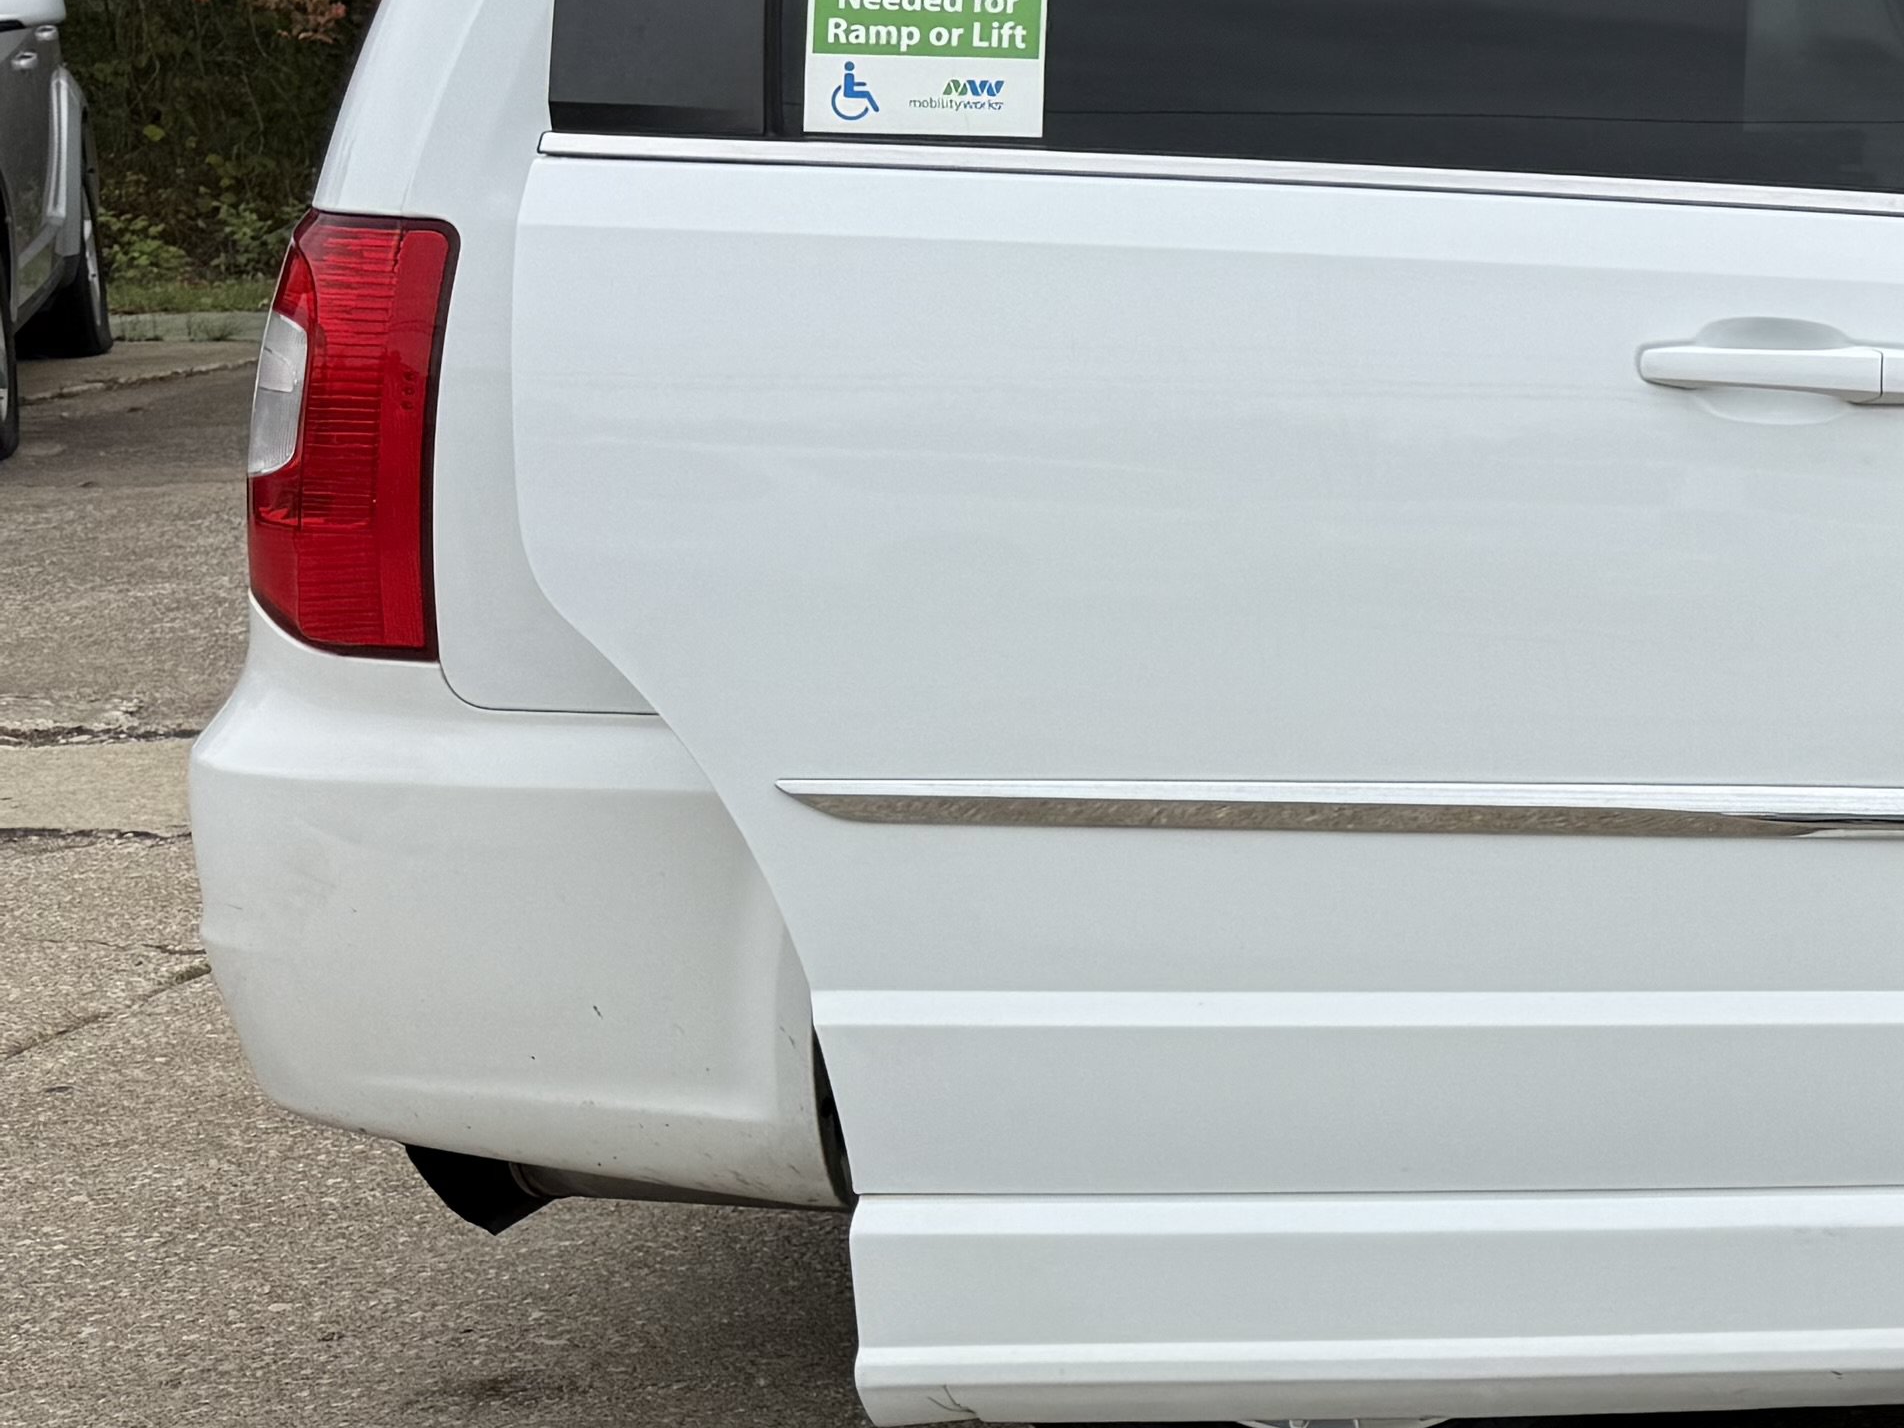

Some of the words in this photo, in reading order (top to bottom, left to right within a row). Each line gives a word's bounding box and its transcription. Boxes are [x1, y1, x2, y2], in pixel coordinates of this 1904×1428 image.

[827, 17, 921, 52] Ramp
[929, 27, 964, 47] or
[972, 22, 1027, 49] Lift
